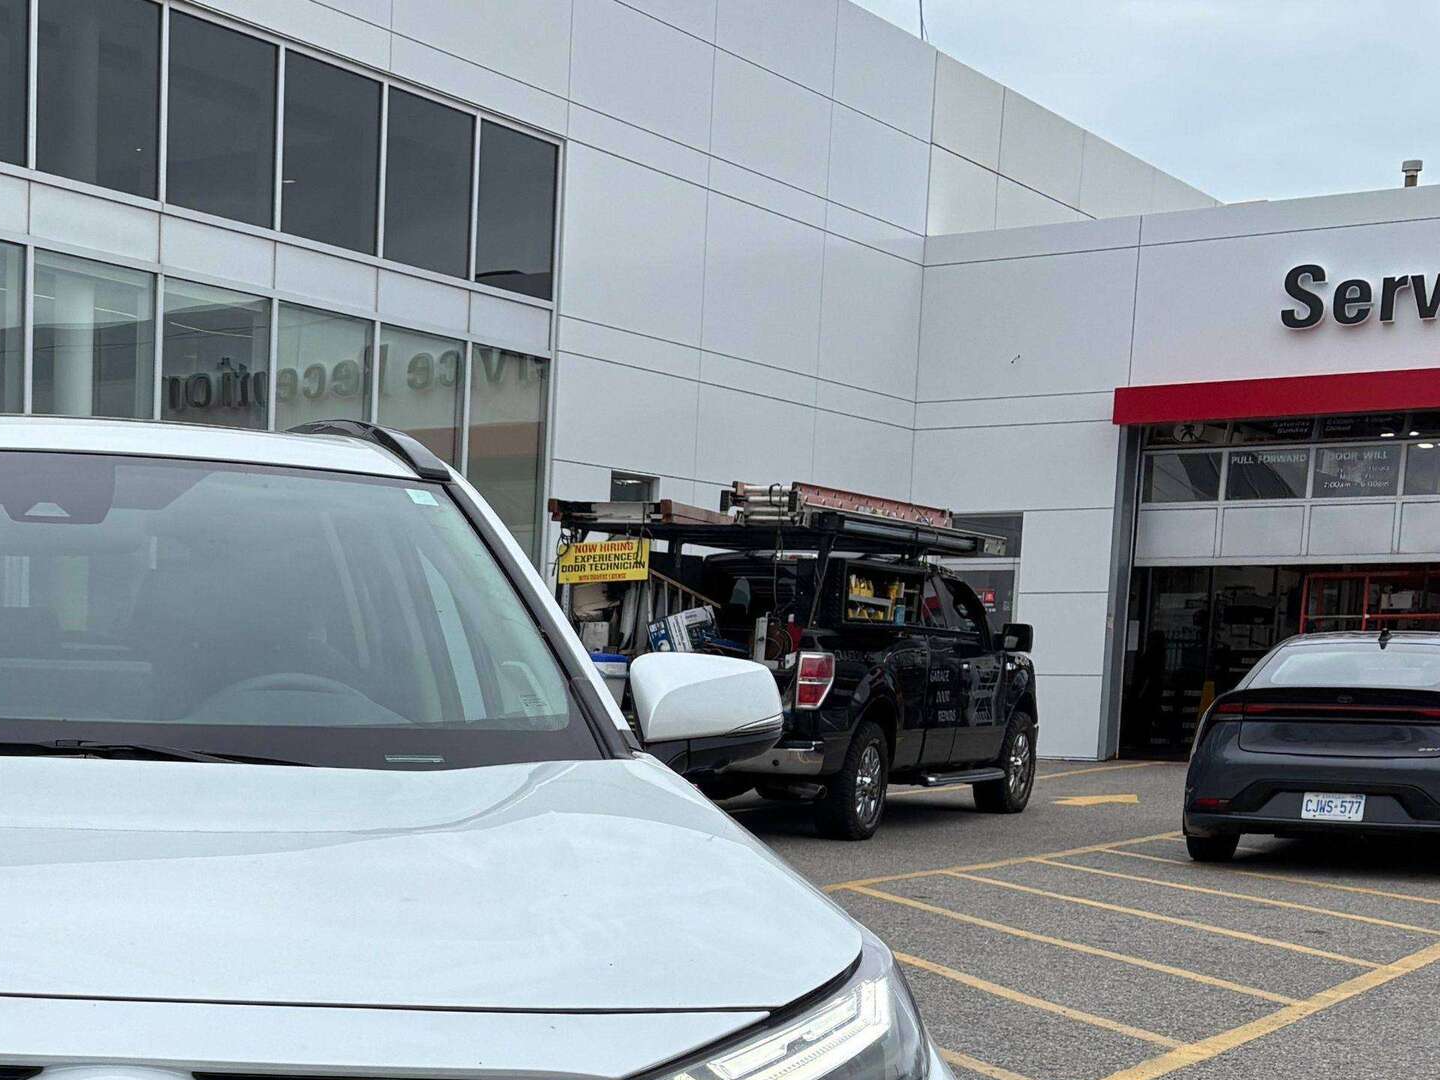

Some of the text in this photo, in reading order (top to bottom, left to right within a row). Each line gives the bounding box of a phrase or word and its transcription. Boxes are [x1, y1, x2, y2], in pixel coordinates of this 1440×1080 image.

[1280, 263, 1440, 330] Serv
[1231, 456, 1254, 465] PULL
[574, 542, 634, 553] NOW HIRING
[561, 561, 646, 573] DOOR TECHNICIAN
